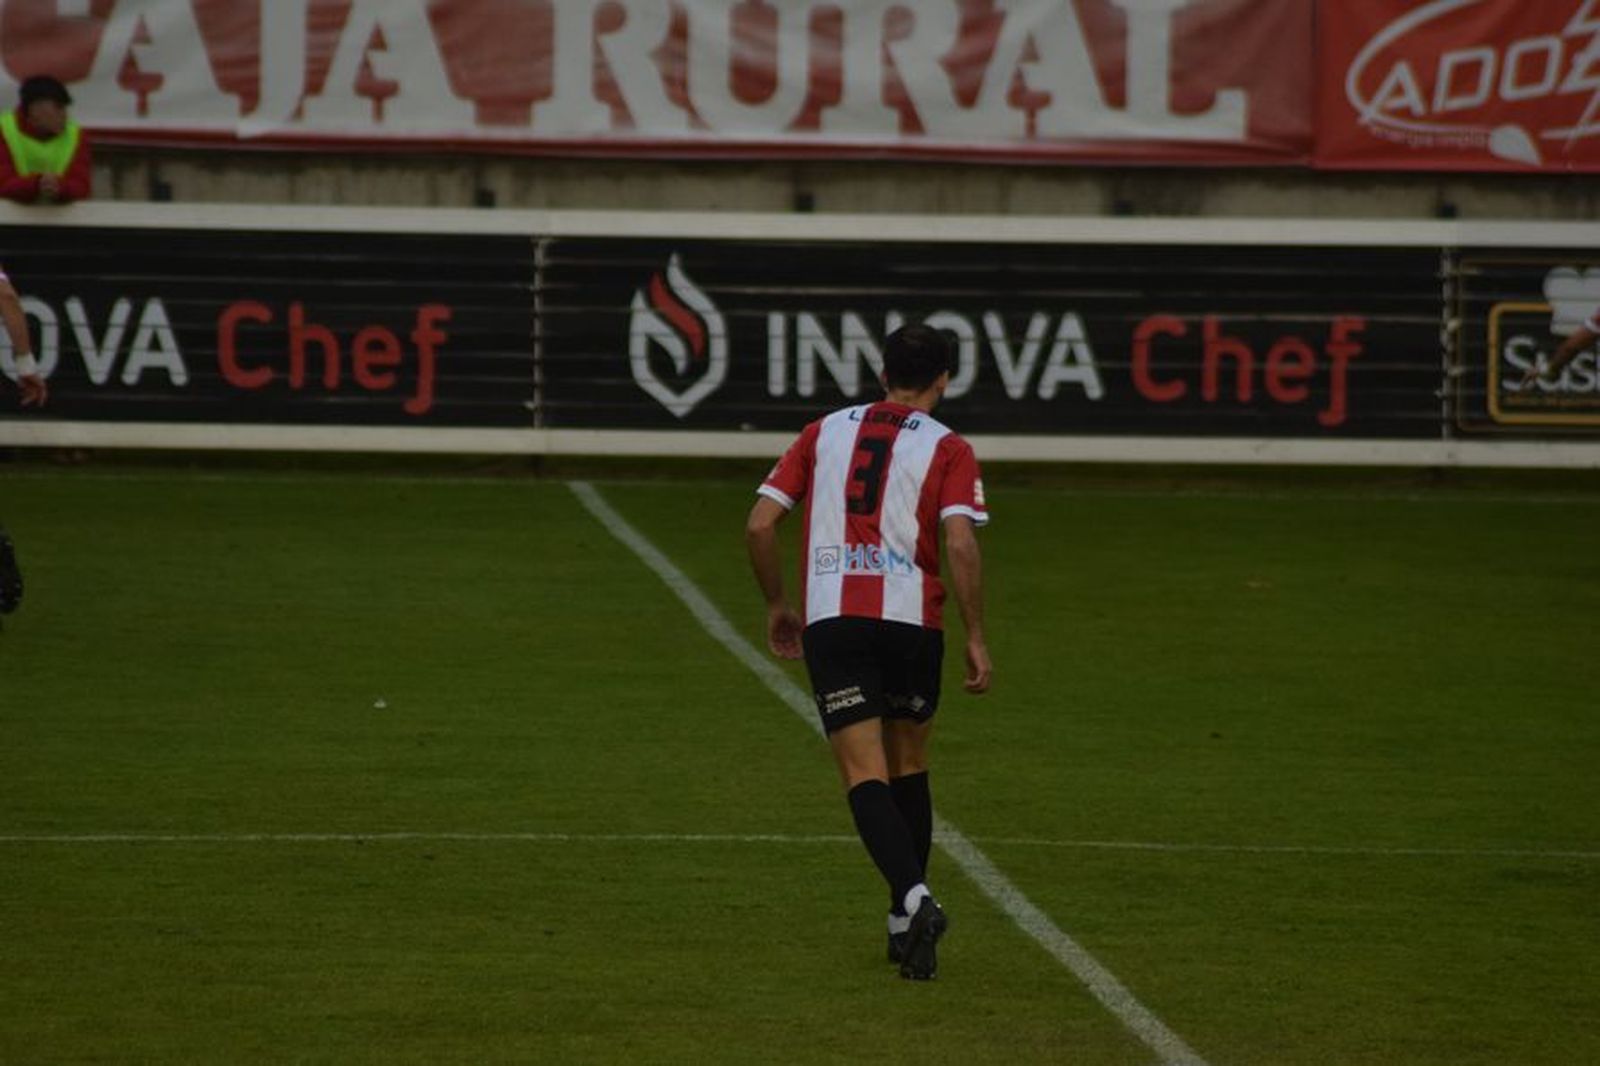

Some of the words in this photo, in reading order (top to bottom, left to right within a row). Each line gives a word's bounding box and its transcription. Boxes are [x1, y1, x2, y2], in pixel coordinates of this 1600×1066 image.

[530, 0, 1247, 140] RURAL
[216, 299, 453, 415] Chef
[1130, 314, 1367, 427] Chef
[1502, 335, 1600, 392] Sus
[846, 437, 890, 516] 3
